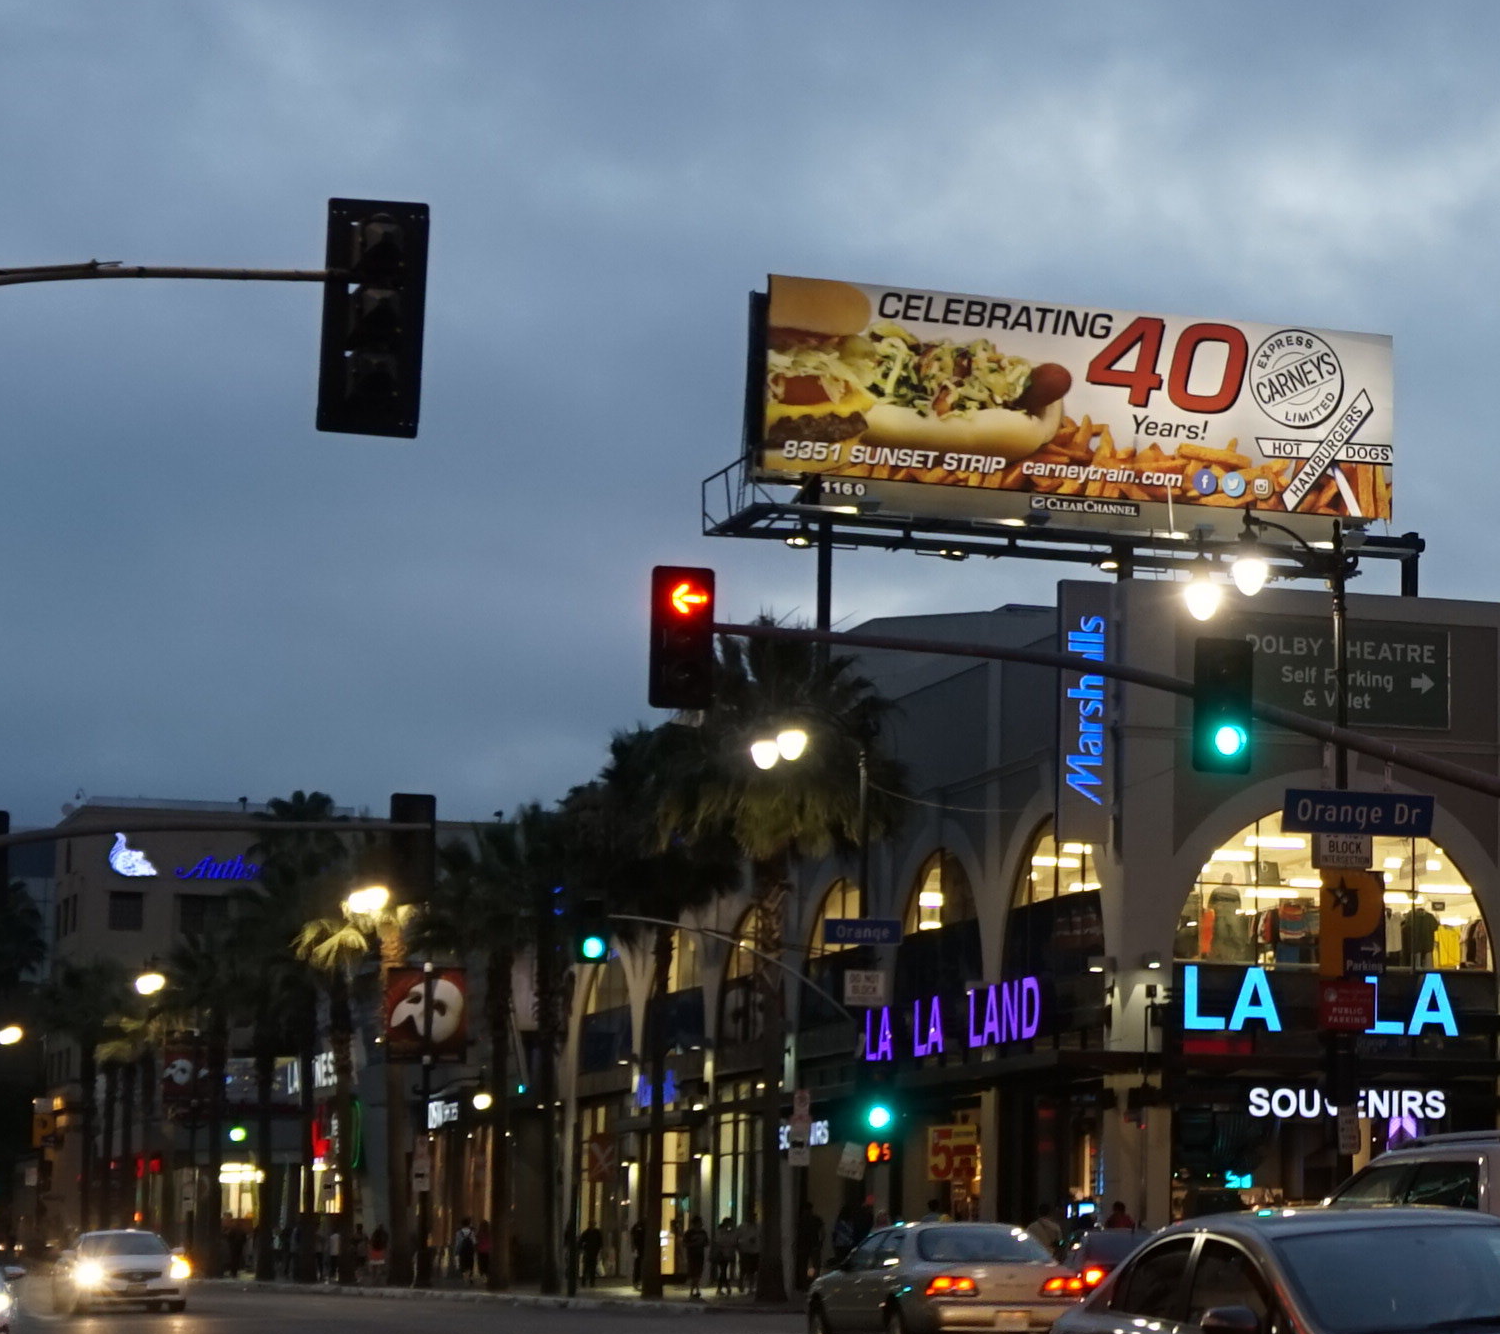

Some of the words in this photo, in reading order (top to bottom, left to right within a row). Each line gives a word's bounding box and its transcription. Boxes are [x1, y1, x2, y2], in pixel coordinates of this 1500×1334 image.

[878, 291, 1114, 342] CELEBRATING
[1086, 316, 1248, 414] 40
[1257, 335, 1314, 370] EXPRESS
[1256, 351, 1337, 406] CARNEYS
[1284, 392, 1336, 423] LIMITED
[1132, 413, 1209, 441] Years!
[781, 439, 842, 463] 8351
[849, 444, 936, 469] SUNSET
[942, 452, 1006, 475] STRIP
[1272, 441, 1303, 457] HOT
[1345, 444, 1390, 462] DOGS
[1290, 405, 1364, 499] HAMBURGERS
[821, 480, 867, 497] 1160
[1022, 458, 1183, 489] carneytrain.com
[1246, 634, 1323, 657] DOLBY
[1331, 640, 1436, 665] HEATRE
[1281, 666, 1317, 684] Self
[1324, 668, 1394, 692] Prking
[1066, 615, 1105, 806] Marshlls
[1303, 689, 1317, 707] &
[1325, 690, 1371, 710] Vlet
[1297, 797, 1383, 830] Orange
[1394, 802, 1422, 826] Dr
[1322, 853, 1370, 866] INTERSECTION
[1328, 840, 1362, 854] BLOCK
[835, 923, 891, 942] Orange
[1346, 959, 1384, 975] Parking
[1183, 964, 1282, 1032] LA
[1364, 972, 1460, 1037] LA
[1332, 1006, 1364, 1015] PUBLIC
[864, 1005, 893, 1062] LA
[913, 995, 945, 1058] LA
[967, 975, 1041, 1049] LAND
[1328, 1015, 1367, 1025] PARKING
[881, 1142, 892, 1162] 5
